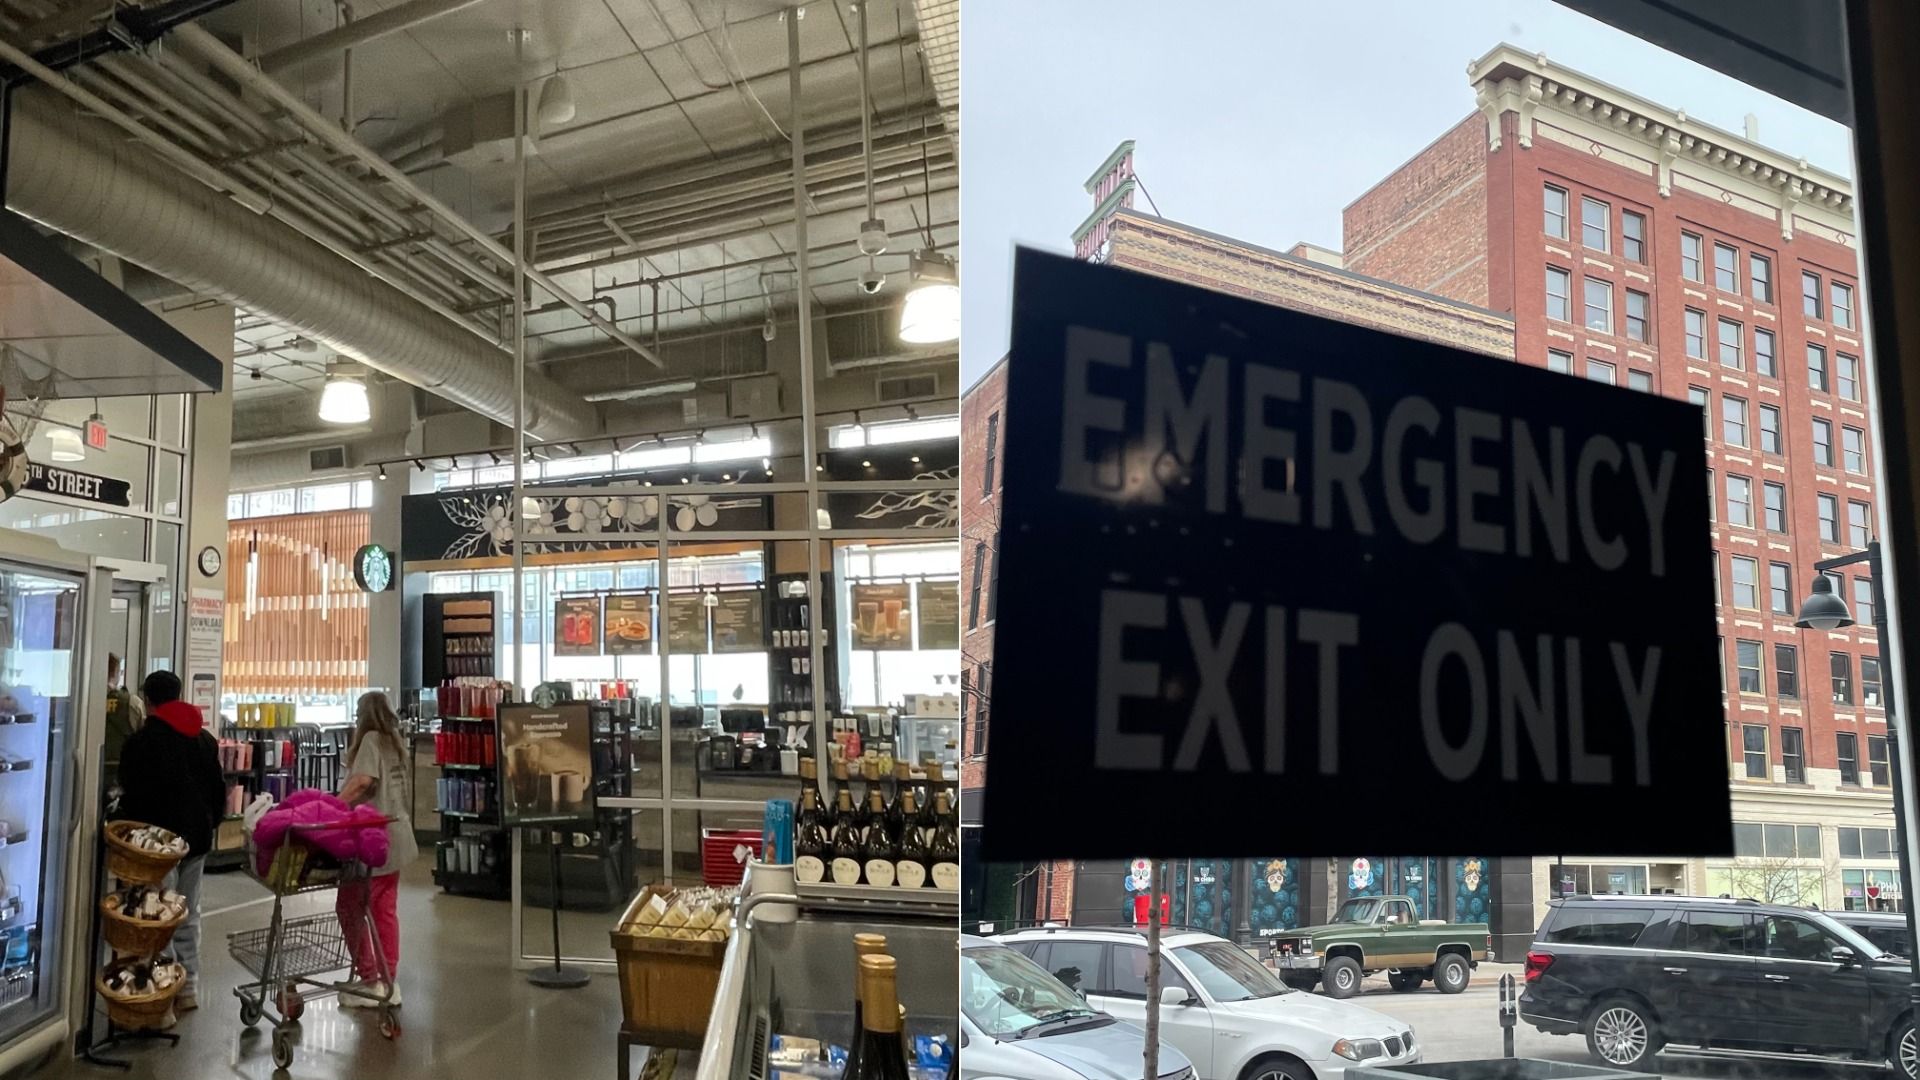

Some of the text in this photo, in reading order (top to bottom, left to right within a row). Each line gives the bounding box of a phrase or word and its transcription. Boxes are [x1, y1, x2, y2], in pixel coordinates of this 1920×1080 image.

[47, 468, 103, 499] STREET
[1056, 324, 1678, 577] EMERGENCY
[522, 722, 568, 730] Handcrafted
[1094, 588, 1662, 787] EXIT ONLY
